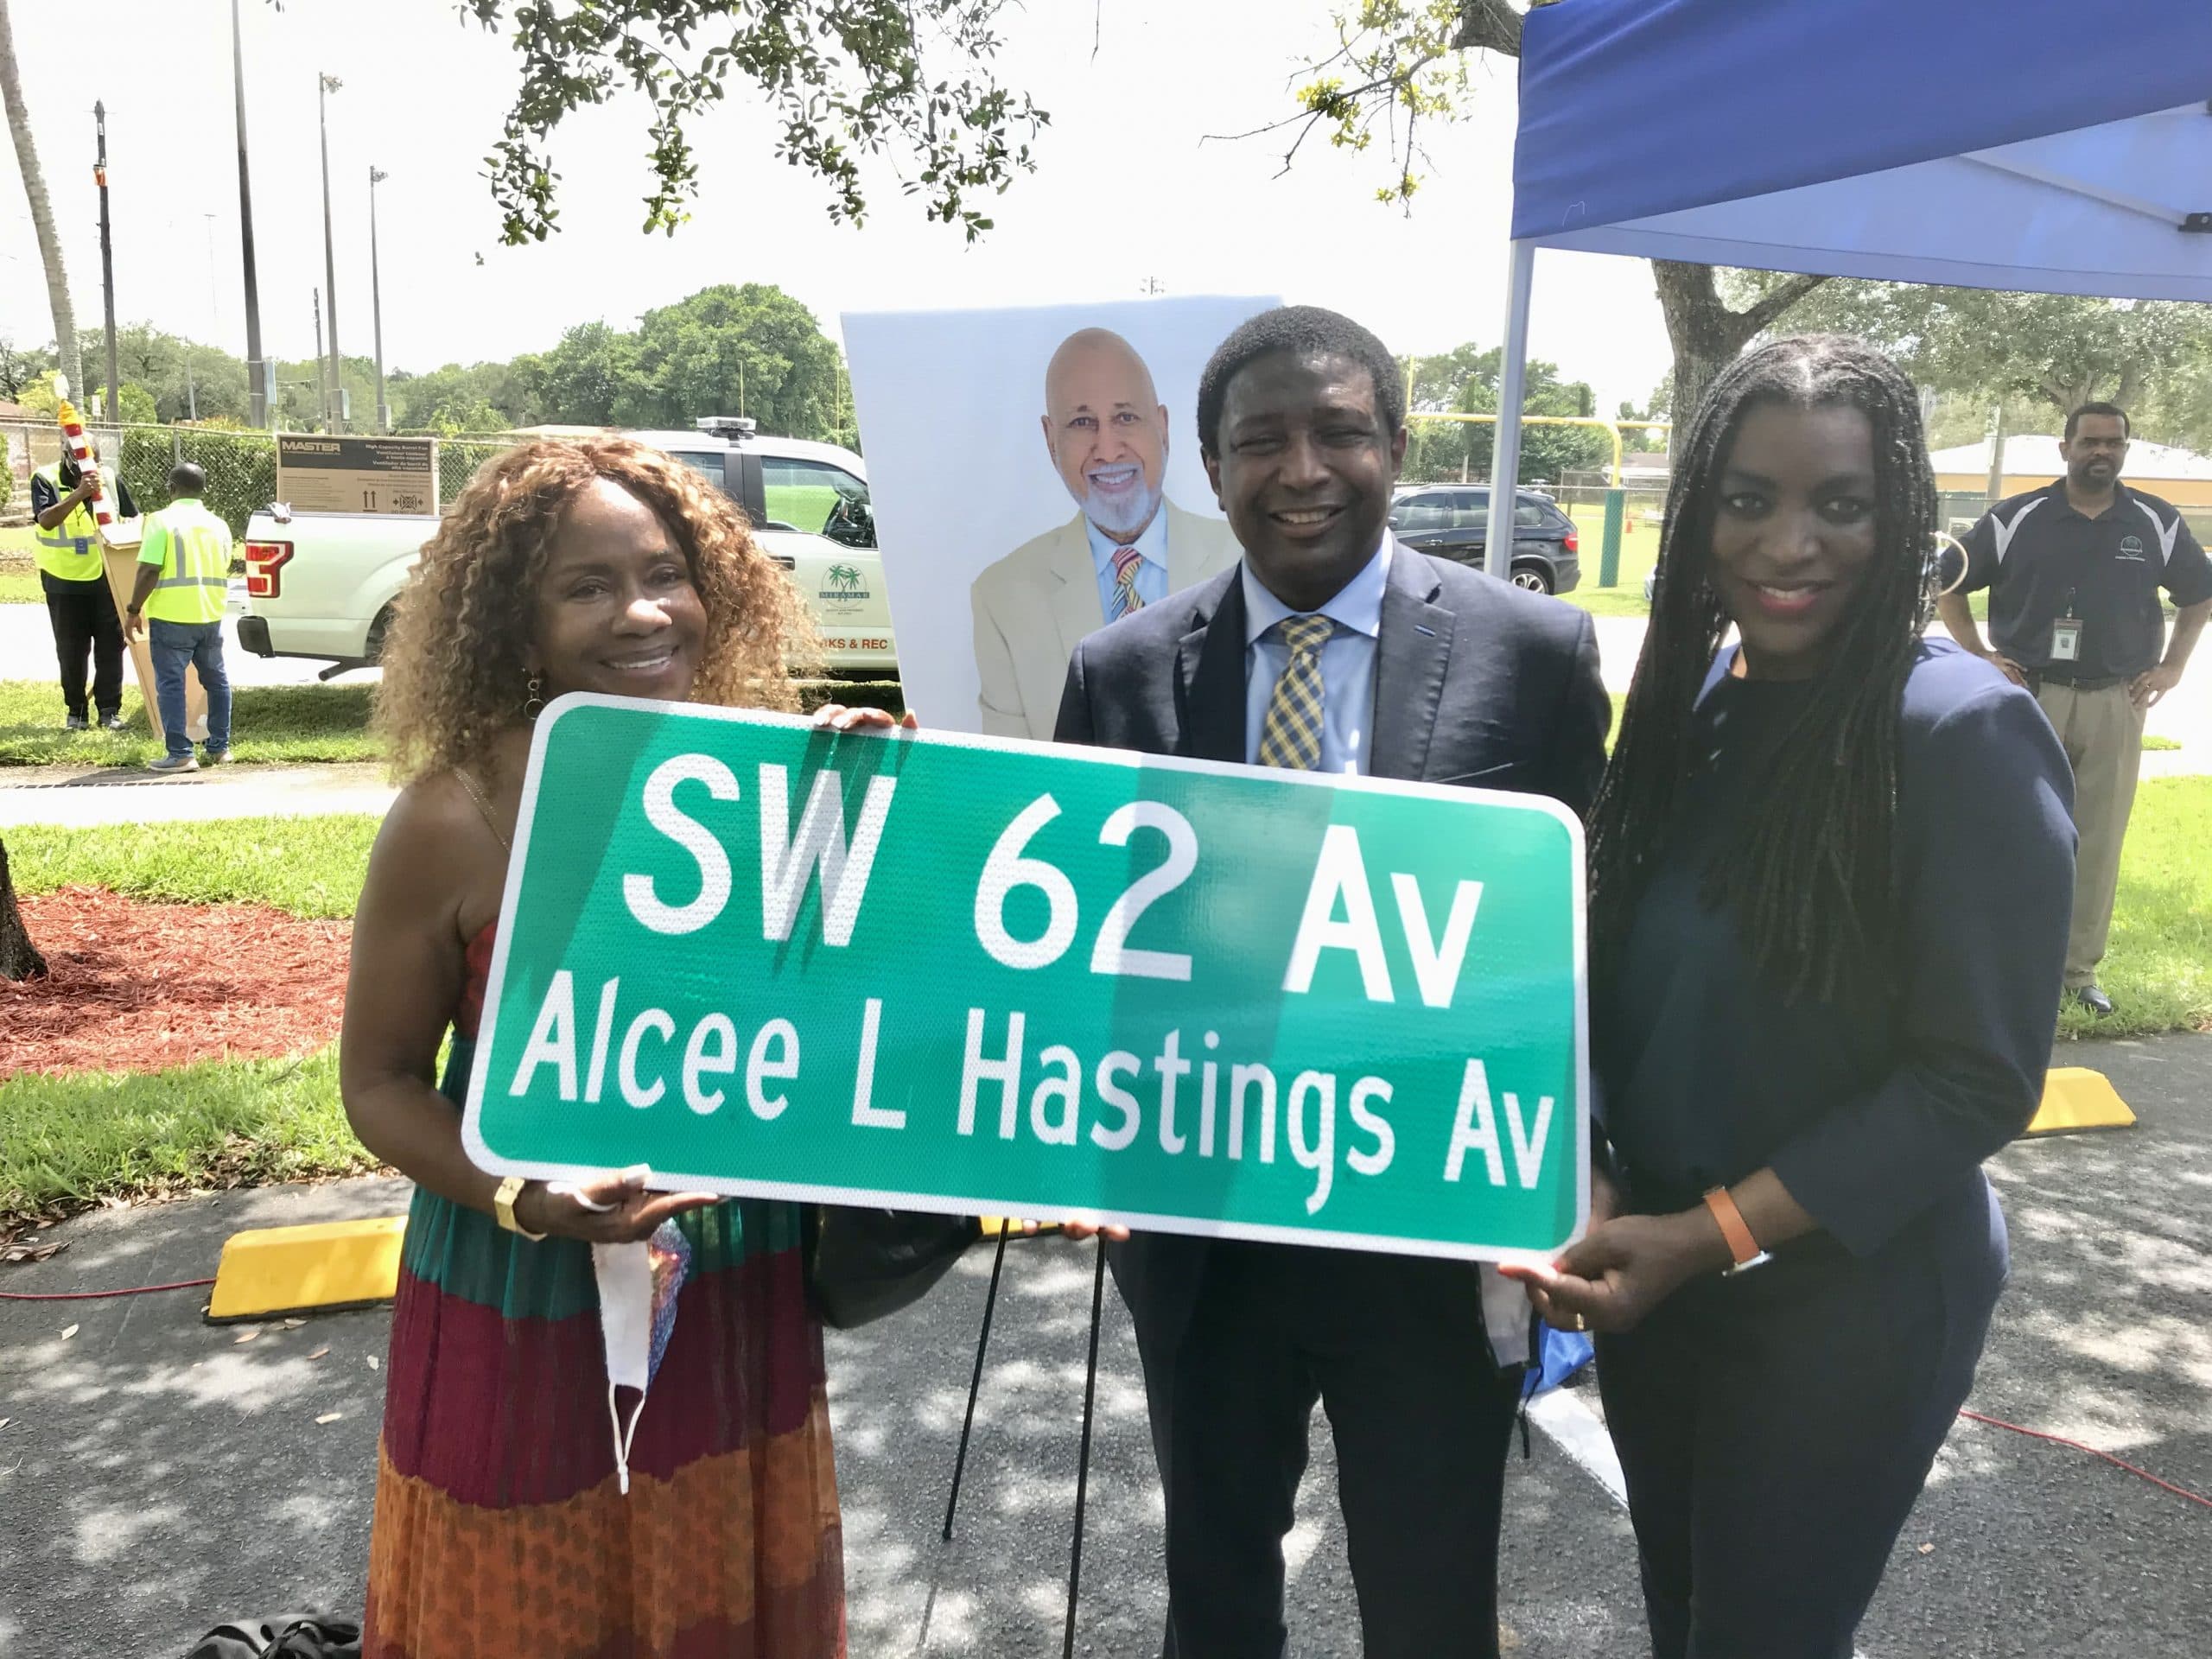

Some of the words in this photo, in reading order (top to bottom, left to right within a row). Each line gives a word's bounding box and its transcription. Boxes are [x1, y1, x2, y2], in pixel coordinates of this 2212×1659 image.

[282, 441, 341, 452] MASTER
[849, 639, 858, 649] &
[861, 639, 888, 650] REC
[624, 753, 896, 946] SW
[975, 793, 1198, 980] 62
[1283, 823, 1484, 1008] Av
[510, 970, 799, 1119] Alcee
[852, 999, 906, 1128] L
[958, 1008, 1394, 1213] Hastings
[1445, 1059, 1554, 1188] Av
